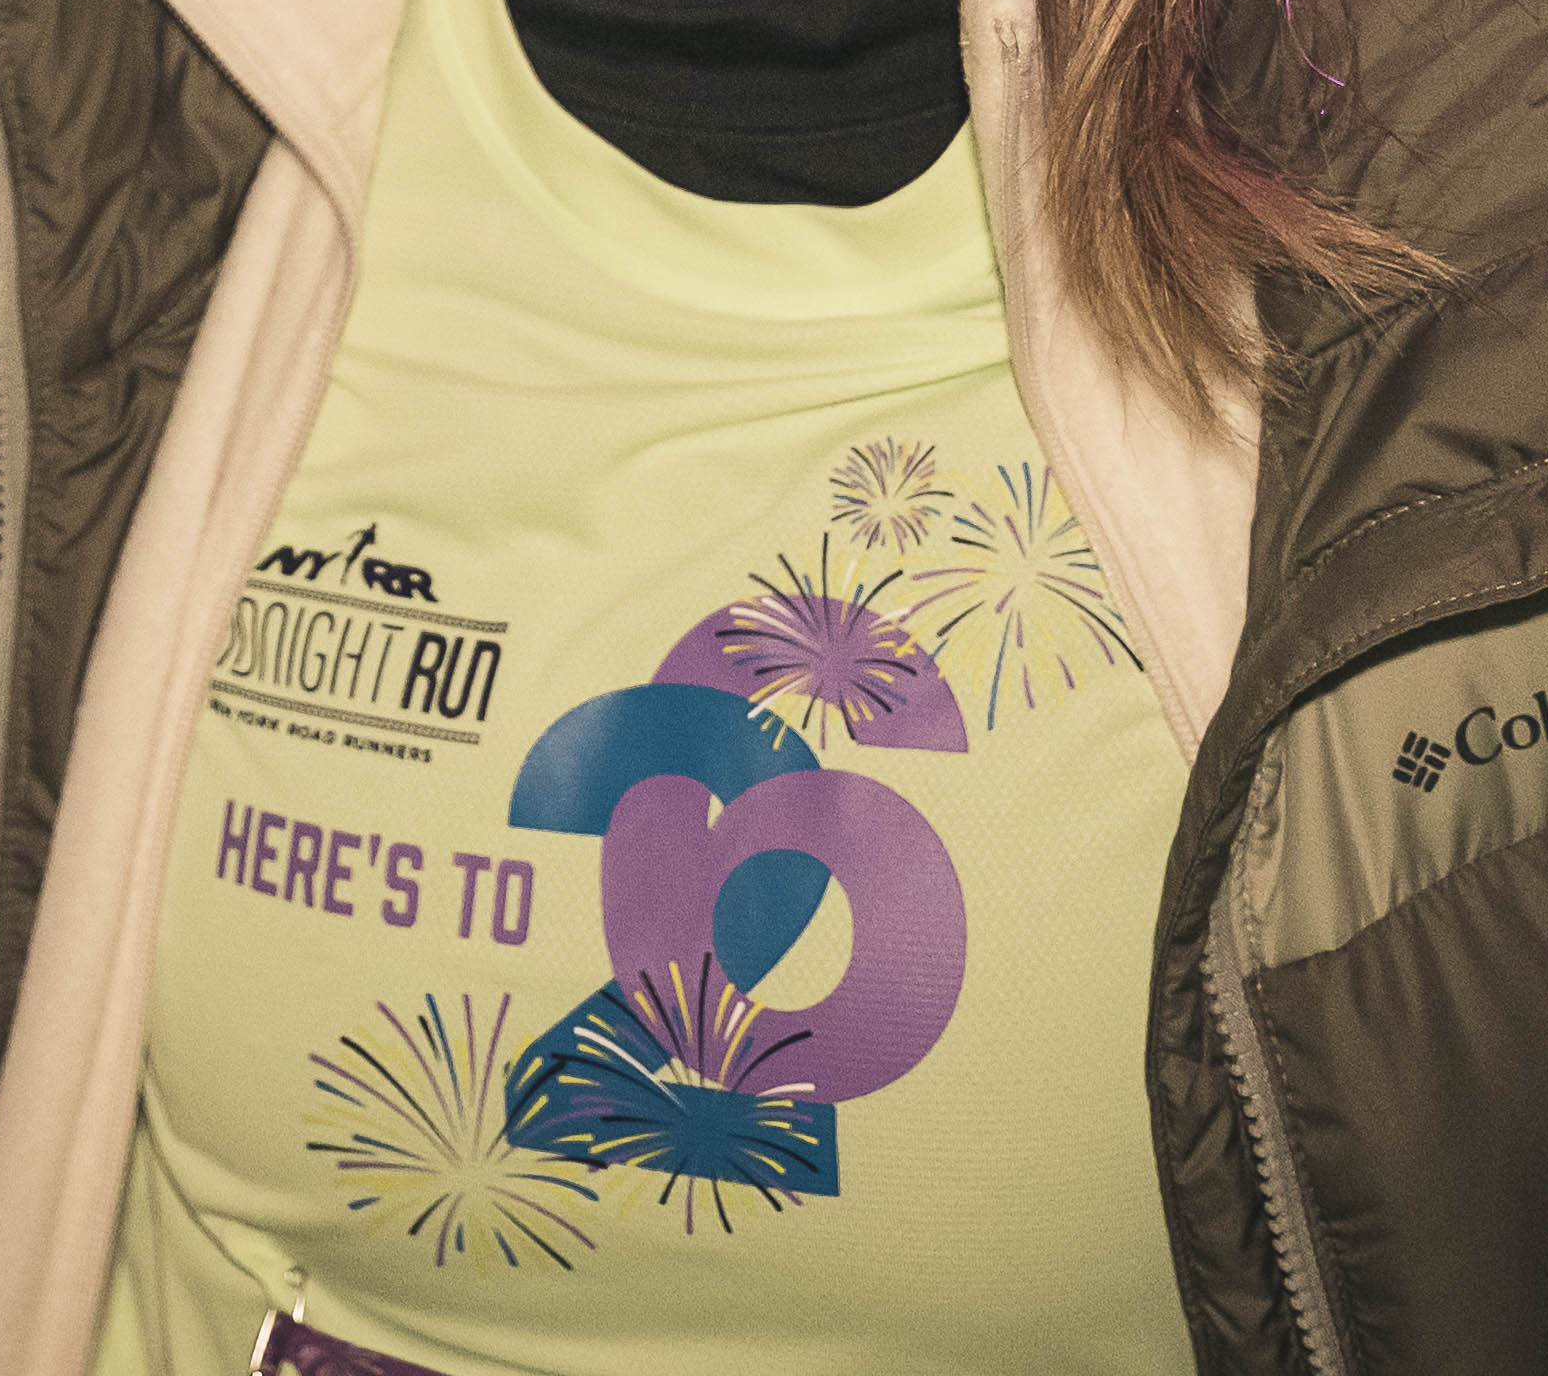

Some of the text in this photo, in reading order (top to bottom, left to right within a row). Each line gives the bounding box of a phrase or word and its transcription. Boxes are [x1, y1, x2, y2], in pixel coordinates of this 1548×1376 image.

[400, 630, 503, 722] RUN
[216, 798, 535, 947] HERE'S TO
